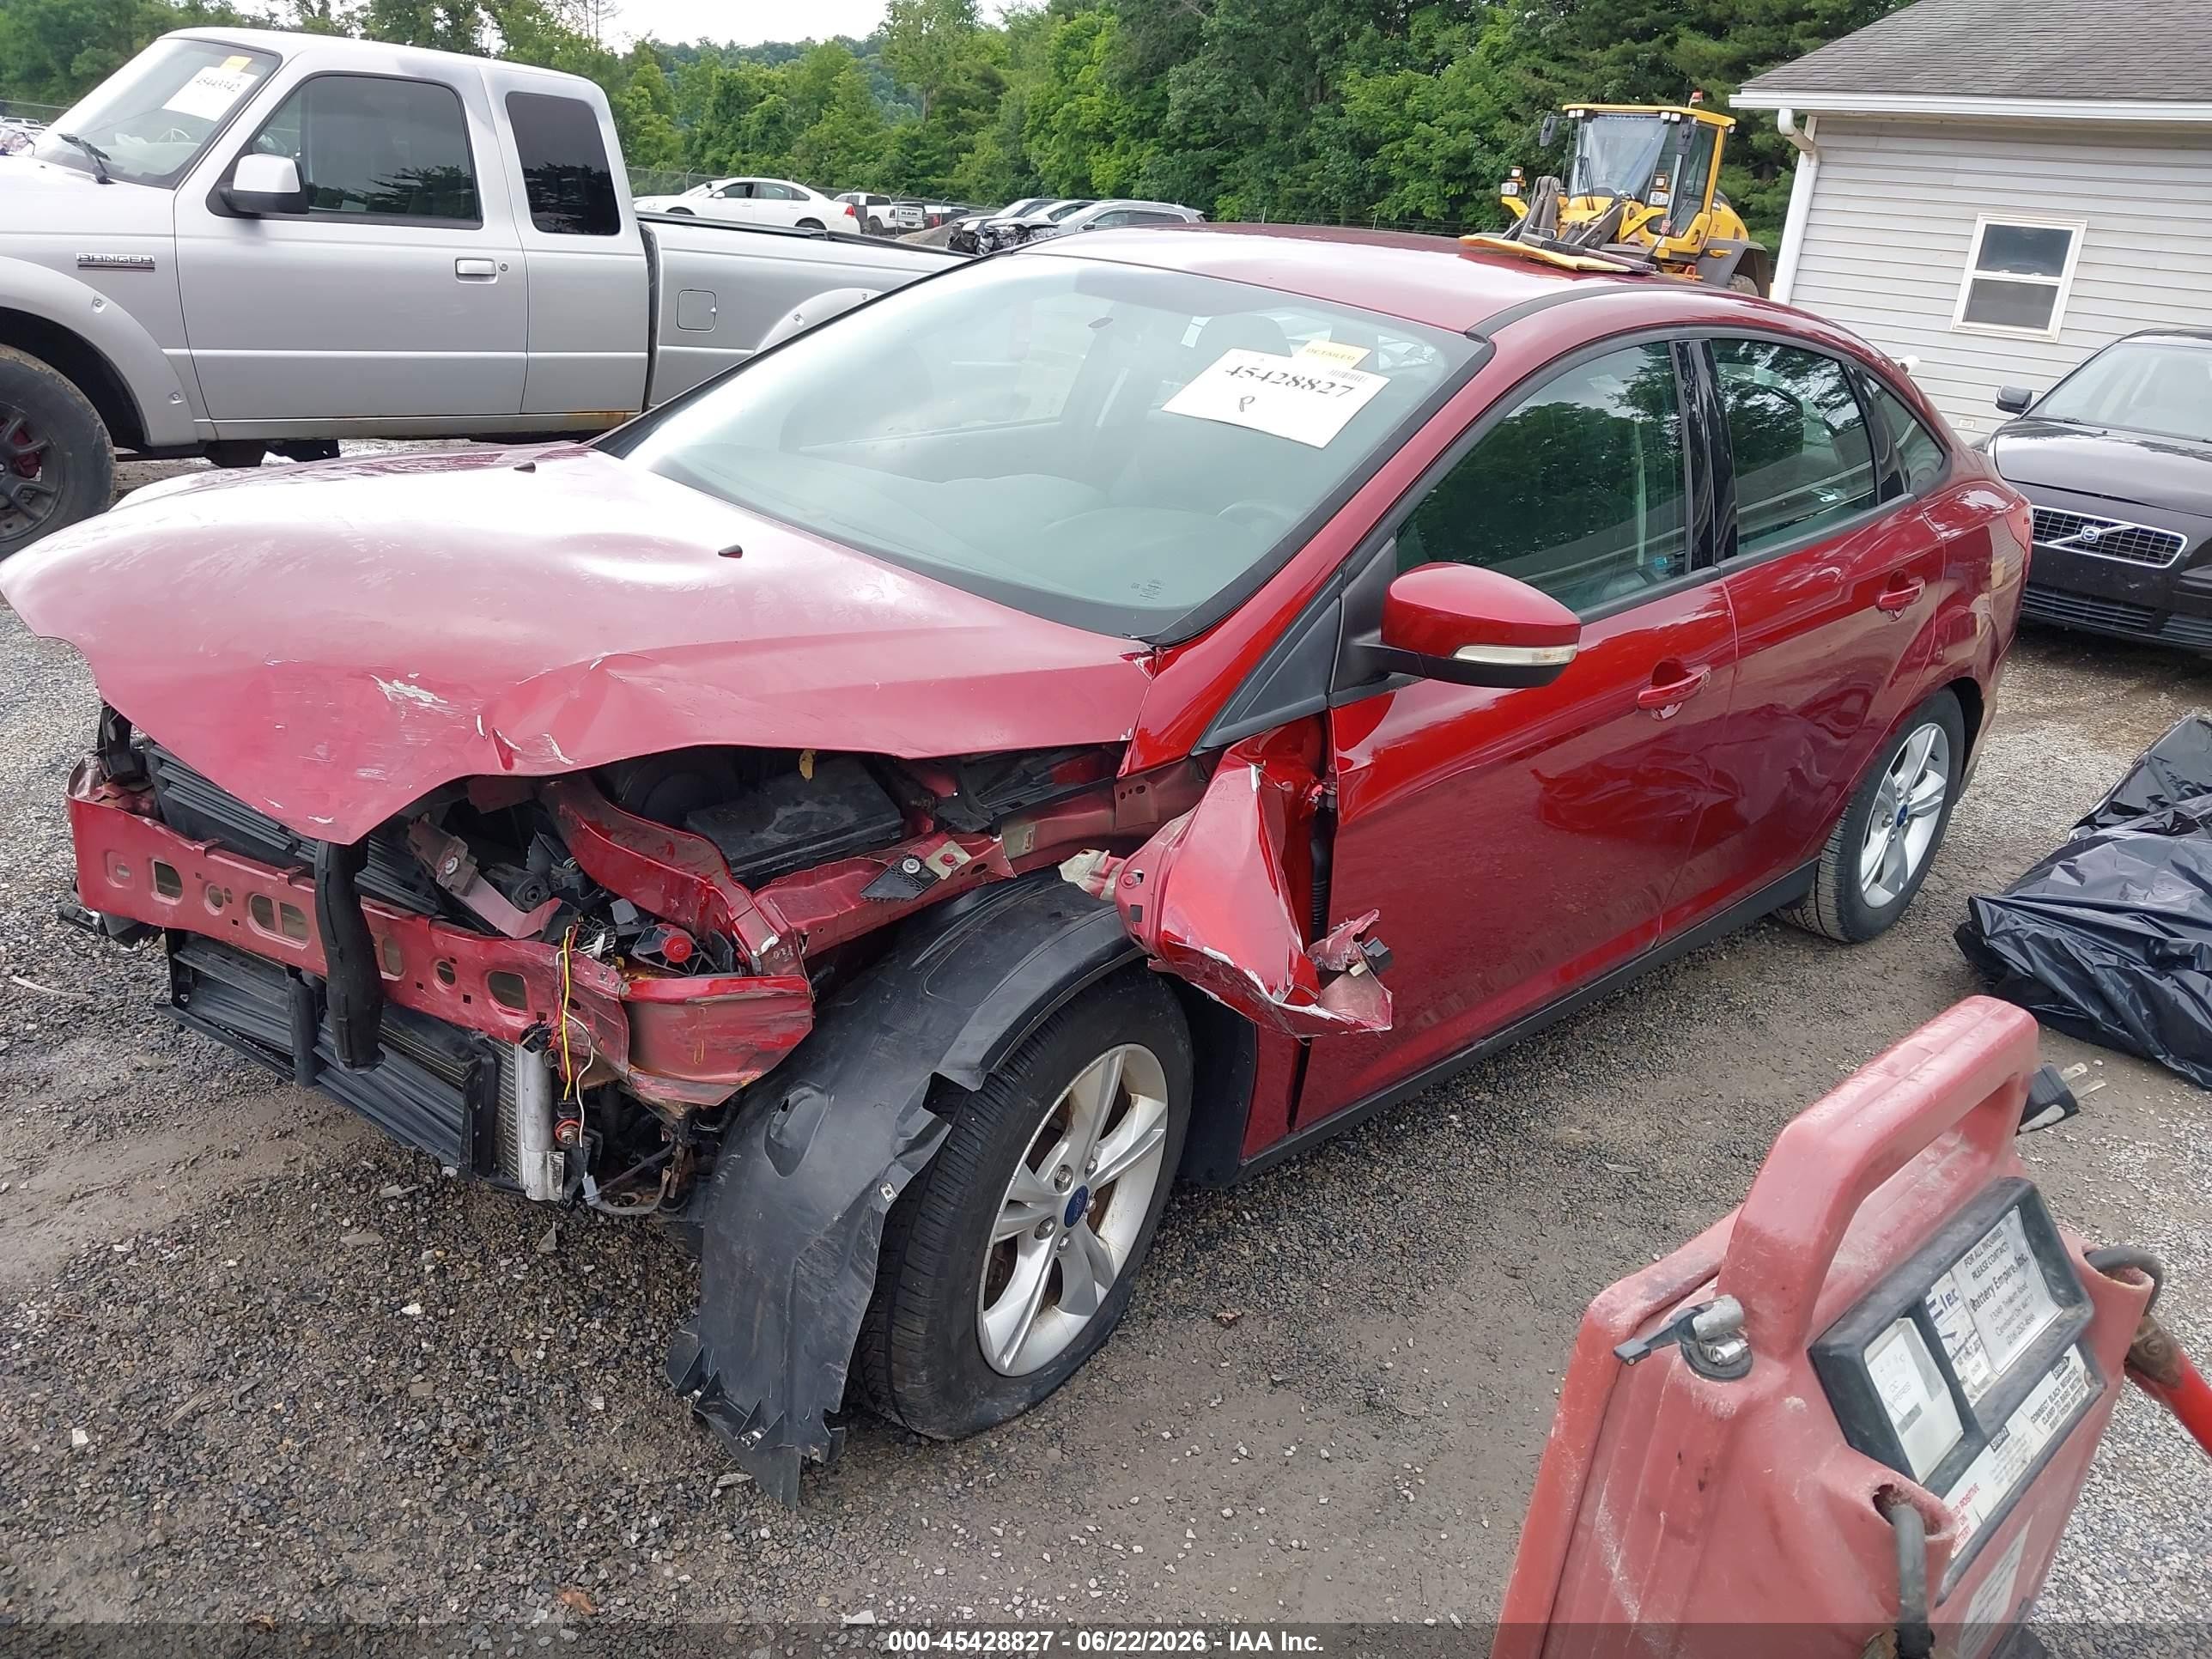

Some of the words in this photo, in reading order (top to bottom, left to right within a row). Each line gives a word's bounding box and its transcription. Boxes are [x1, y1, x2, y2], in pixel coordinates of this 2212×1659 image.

[77, 253, 154, 264] RANGER
[1225, 365, 1355, 398] 45428827
[1972, 1261, 1989, 1281] PLEASE
